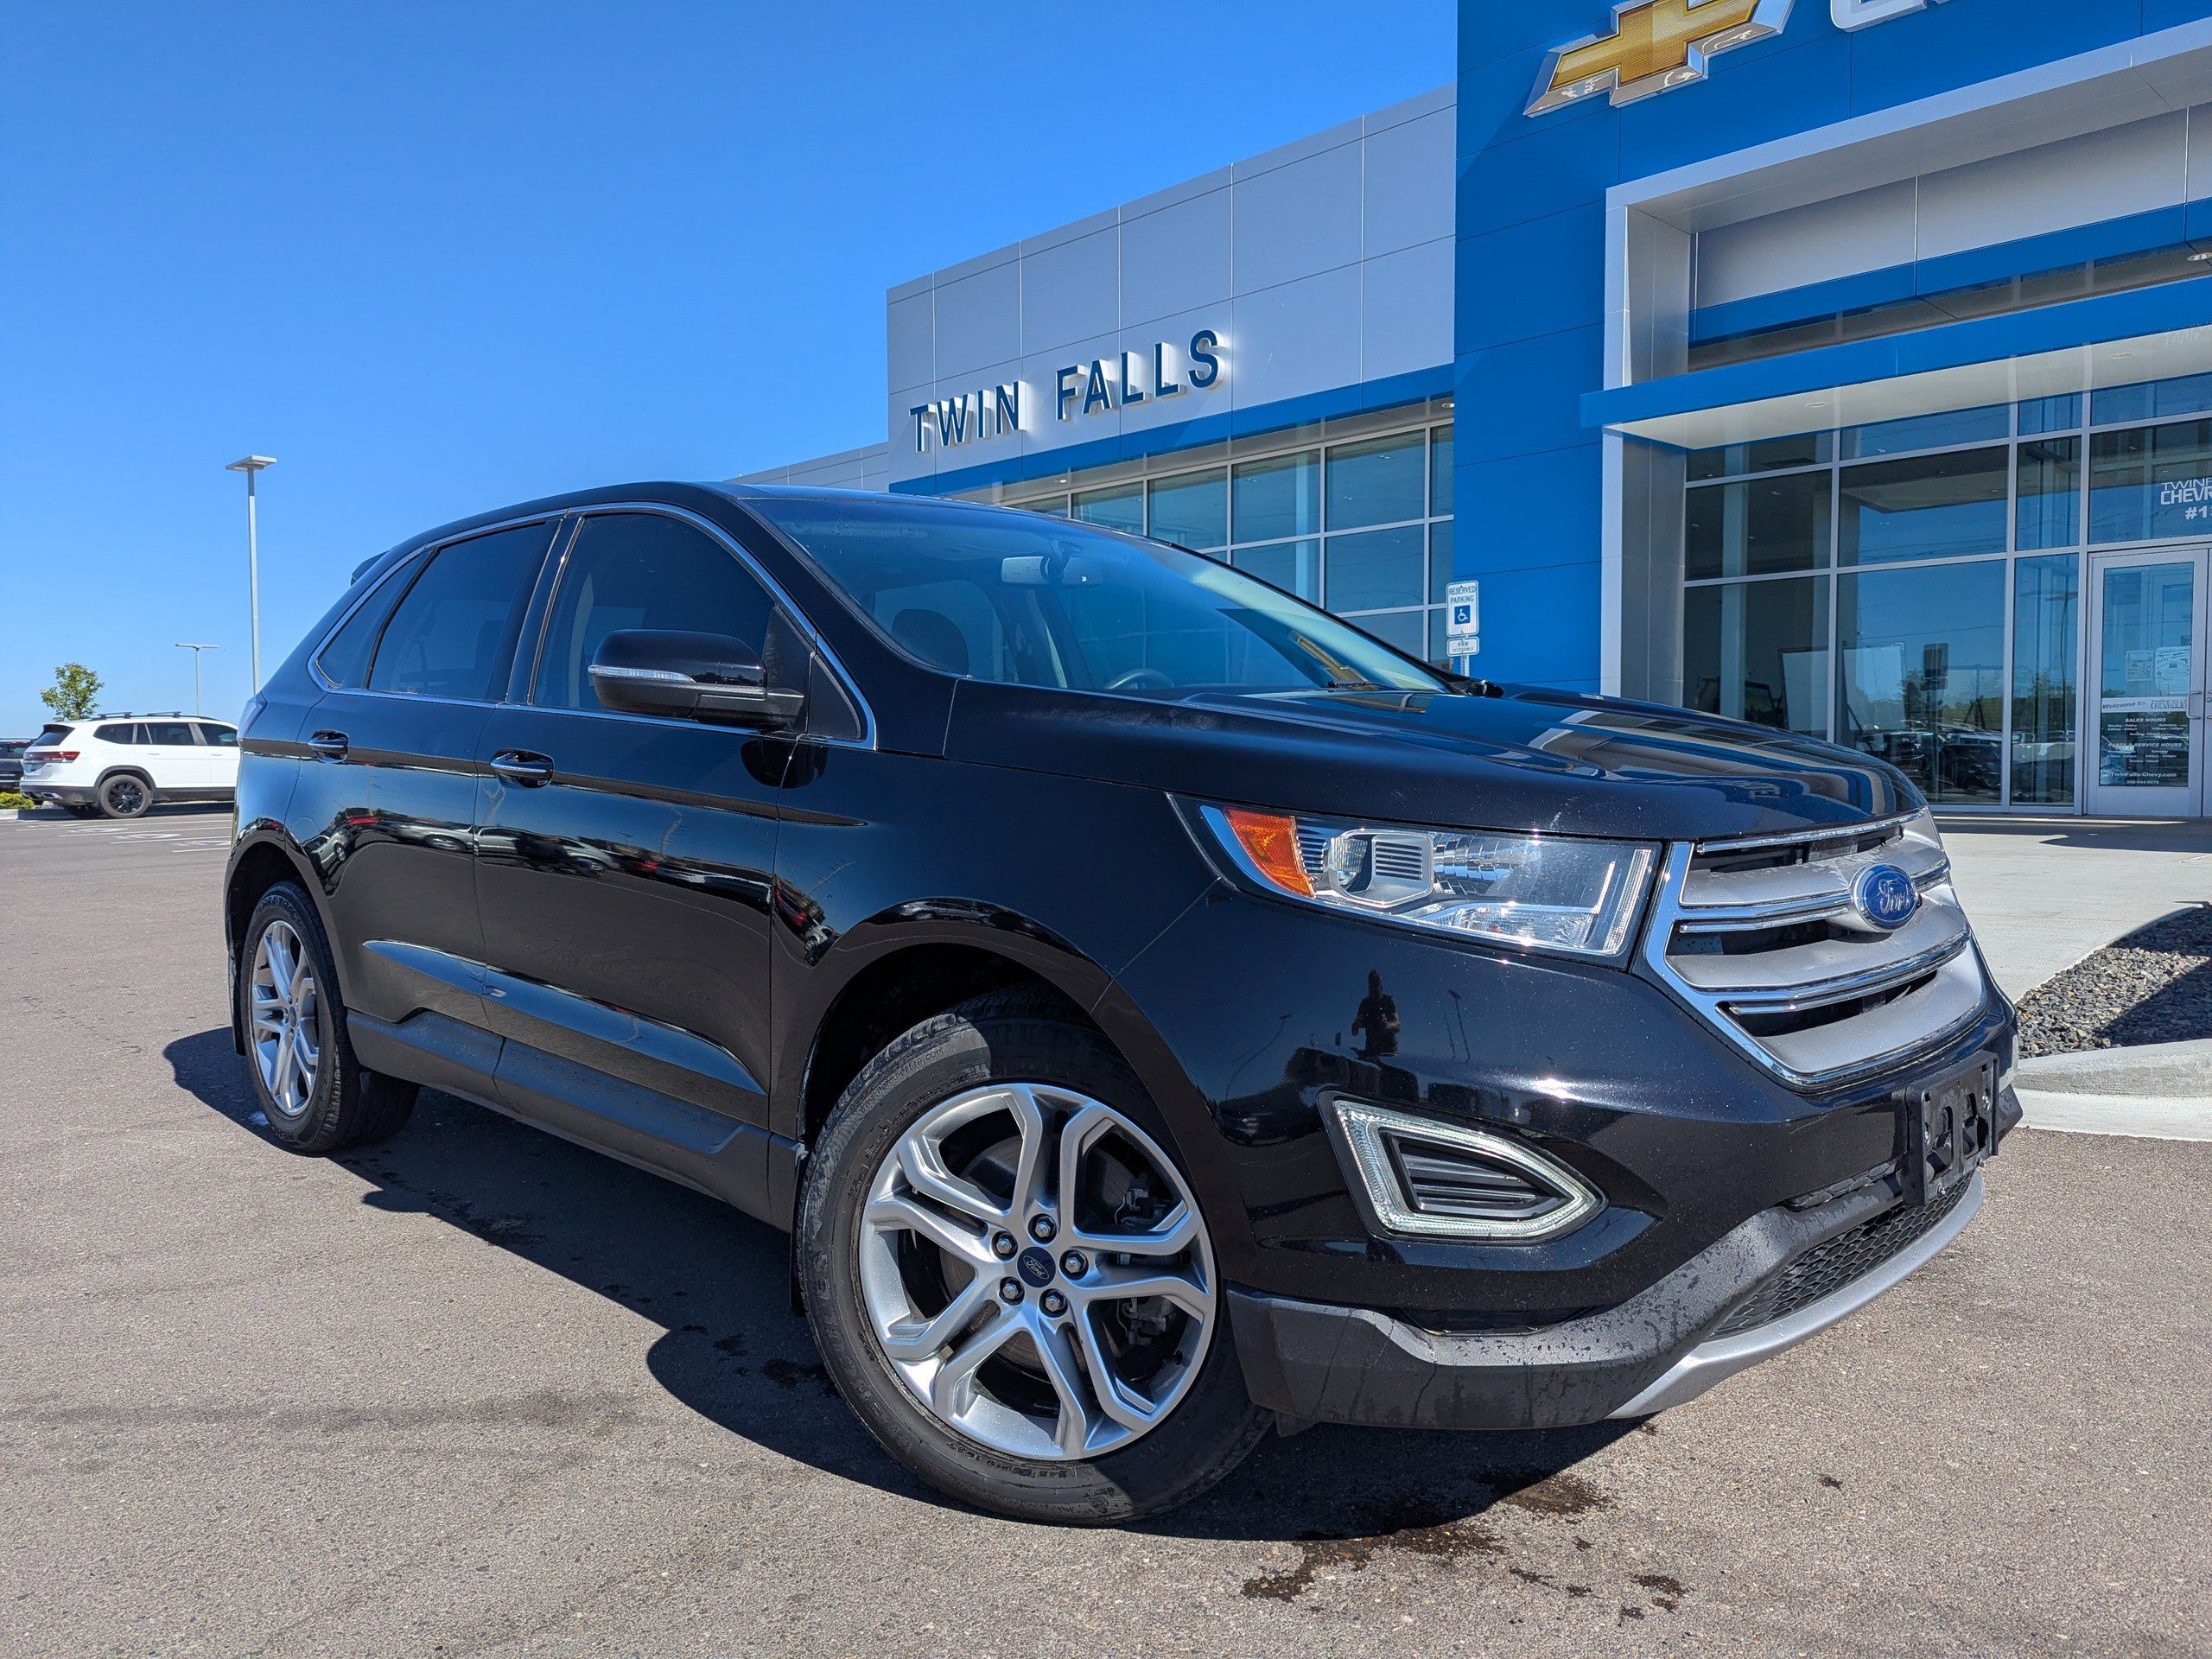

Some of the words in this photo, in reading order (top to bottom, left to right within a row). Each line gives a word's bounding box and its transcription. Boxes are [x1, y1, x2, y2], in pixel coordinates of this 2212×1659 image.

[909, 380, 1027, 453] TWIN
[1056, 329, 1224, 421] FALLS
[2185, 505, 2212, 519] #1
[1448, 586, 1476, 595] RESERVED
[1450, 595, 1474, 604] PARKING
[1876, 878, 1910, 916] Ford
[1026, 1259, 1046, 1277] Ford
